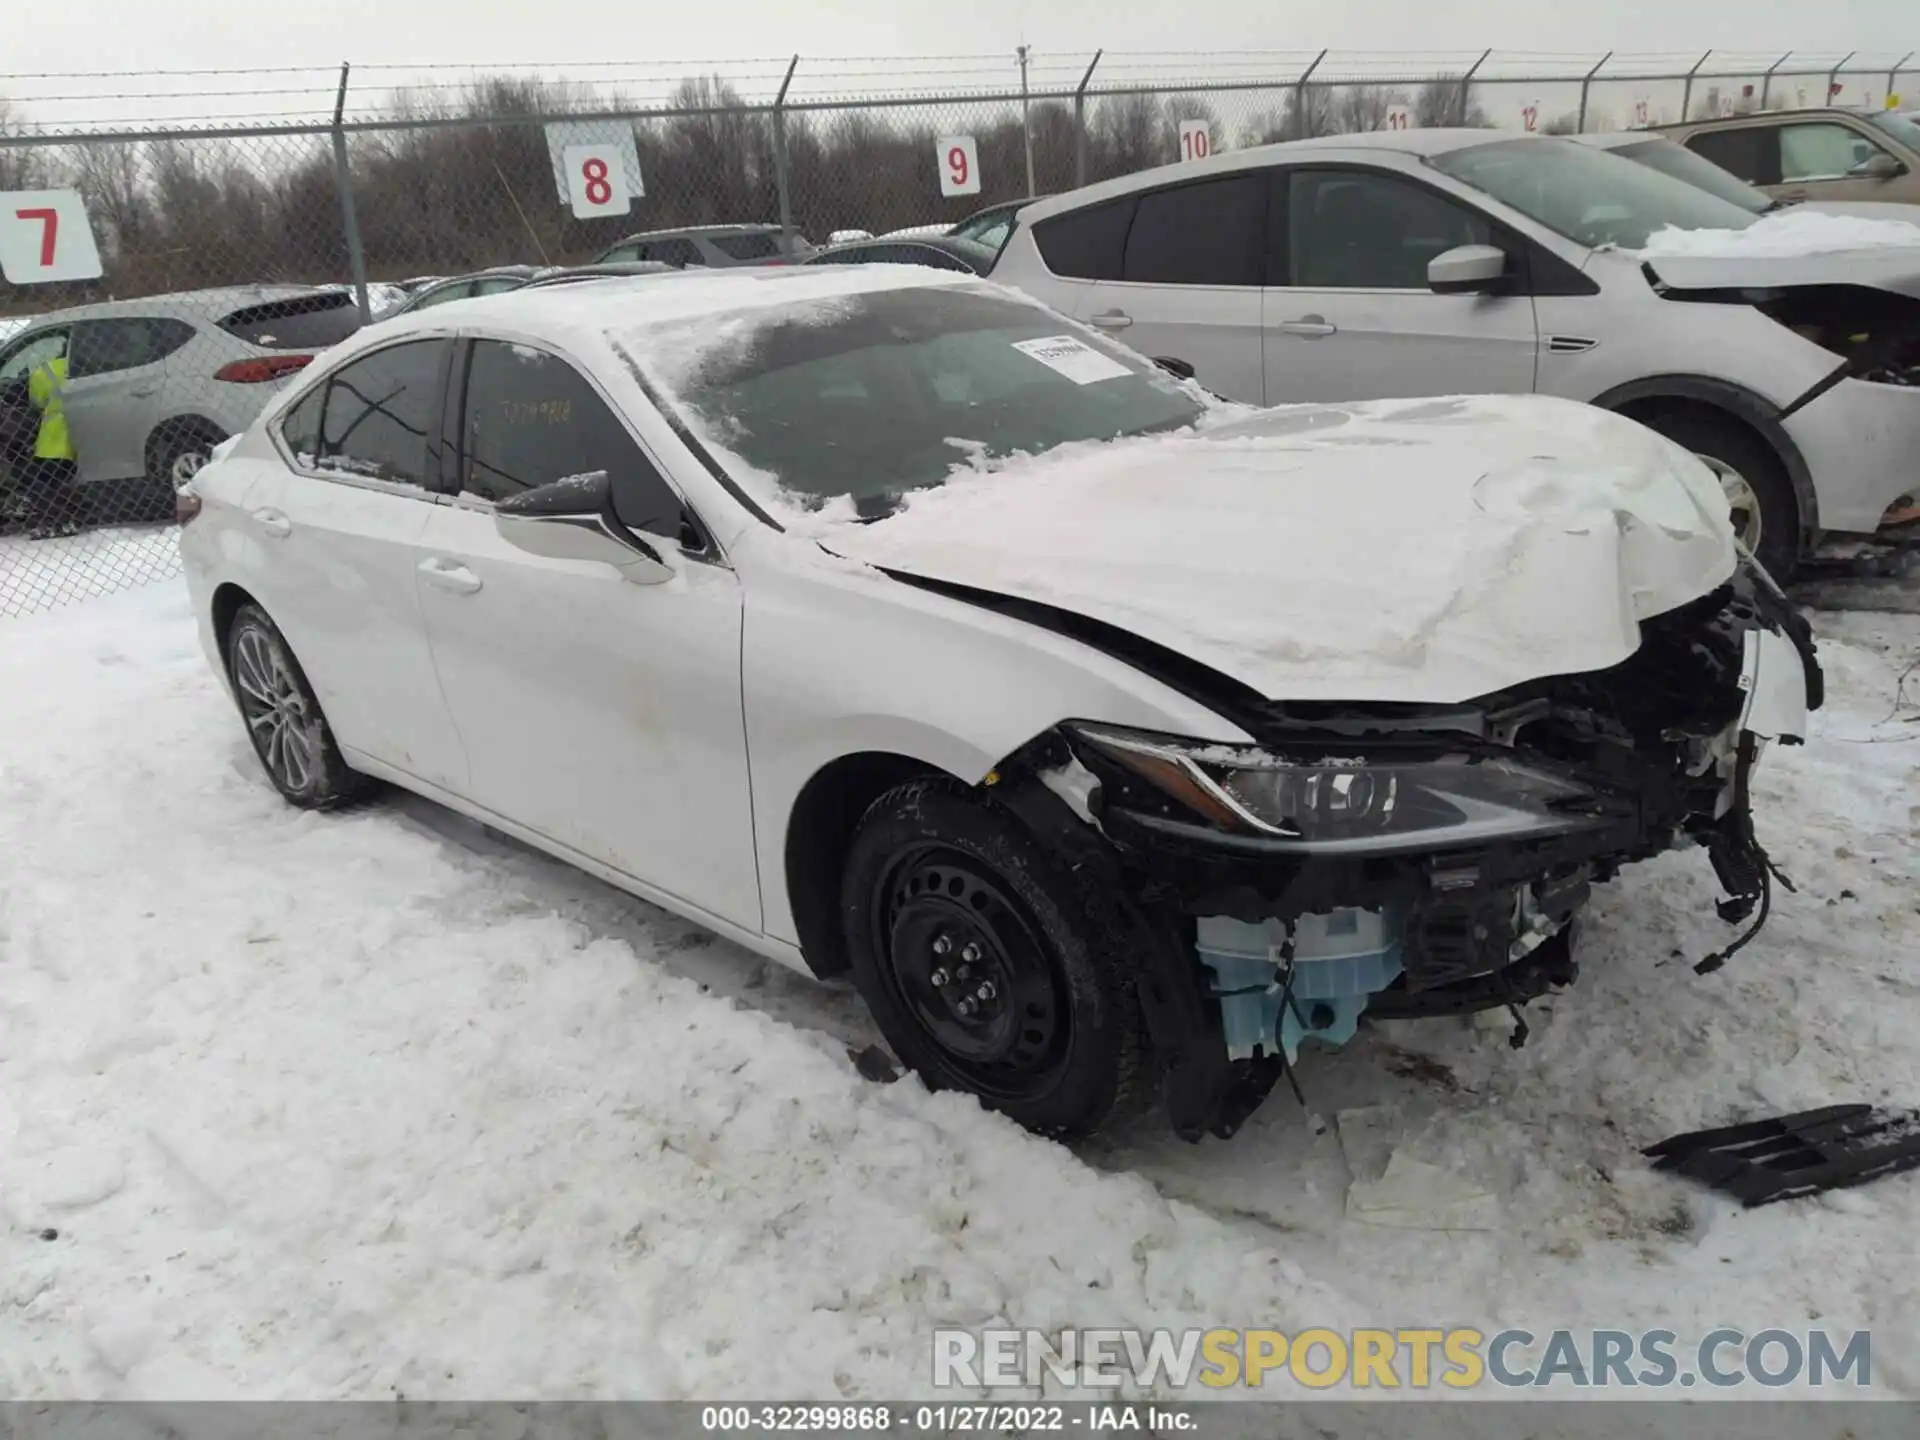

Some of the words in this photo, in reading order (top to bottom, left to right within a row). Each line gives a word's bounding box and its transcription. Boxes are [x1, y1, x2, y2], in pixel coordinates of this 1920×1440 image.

[1389, 111, 1407, 130] 11
[1521, 105, 1538, 132] 12
[1183, 130, 1208, 160] 10
[582, 157, 612, 205] 8
[948, 147, 968, 185] 9
[16, 208, 58, 267] 7
